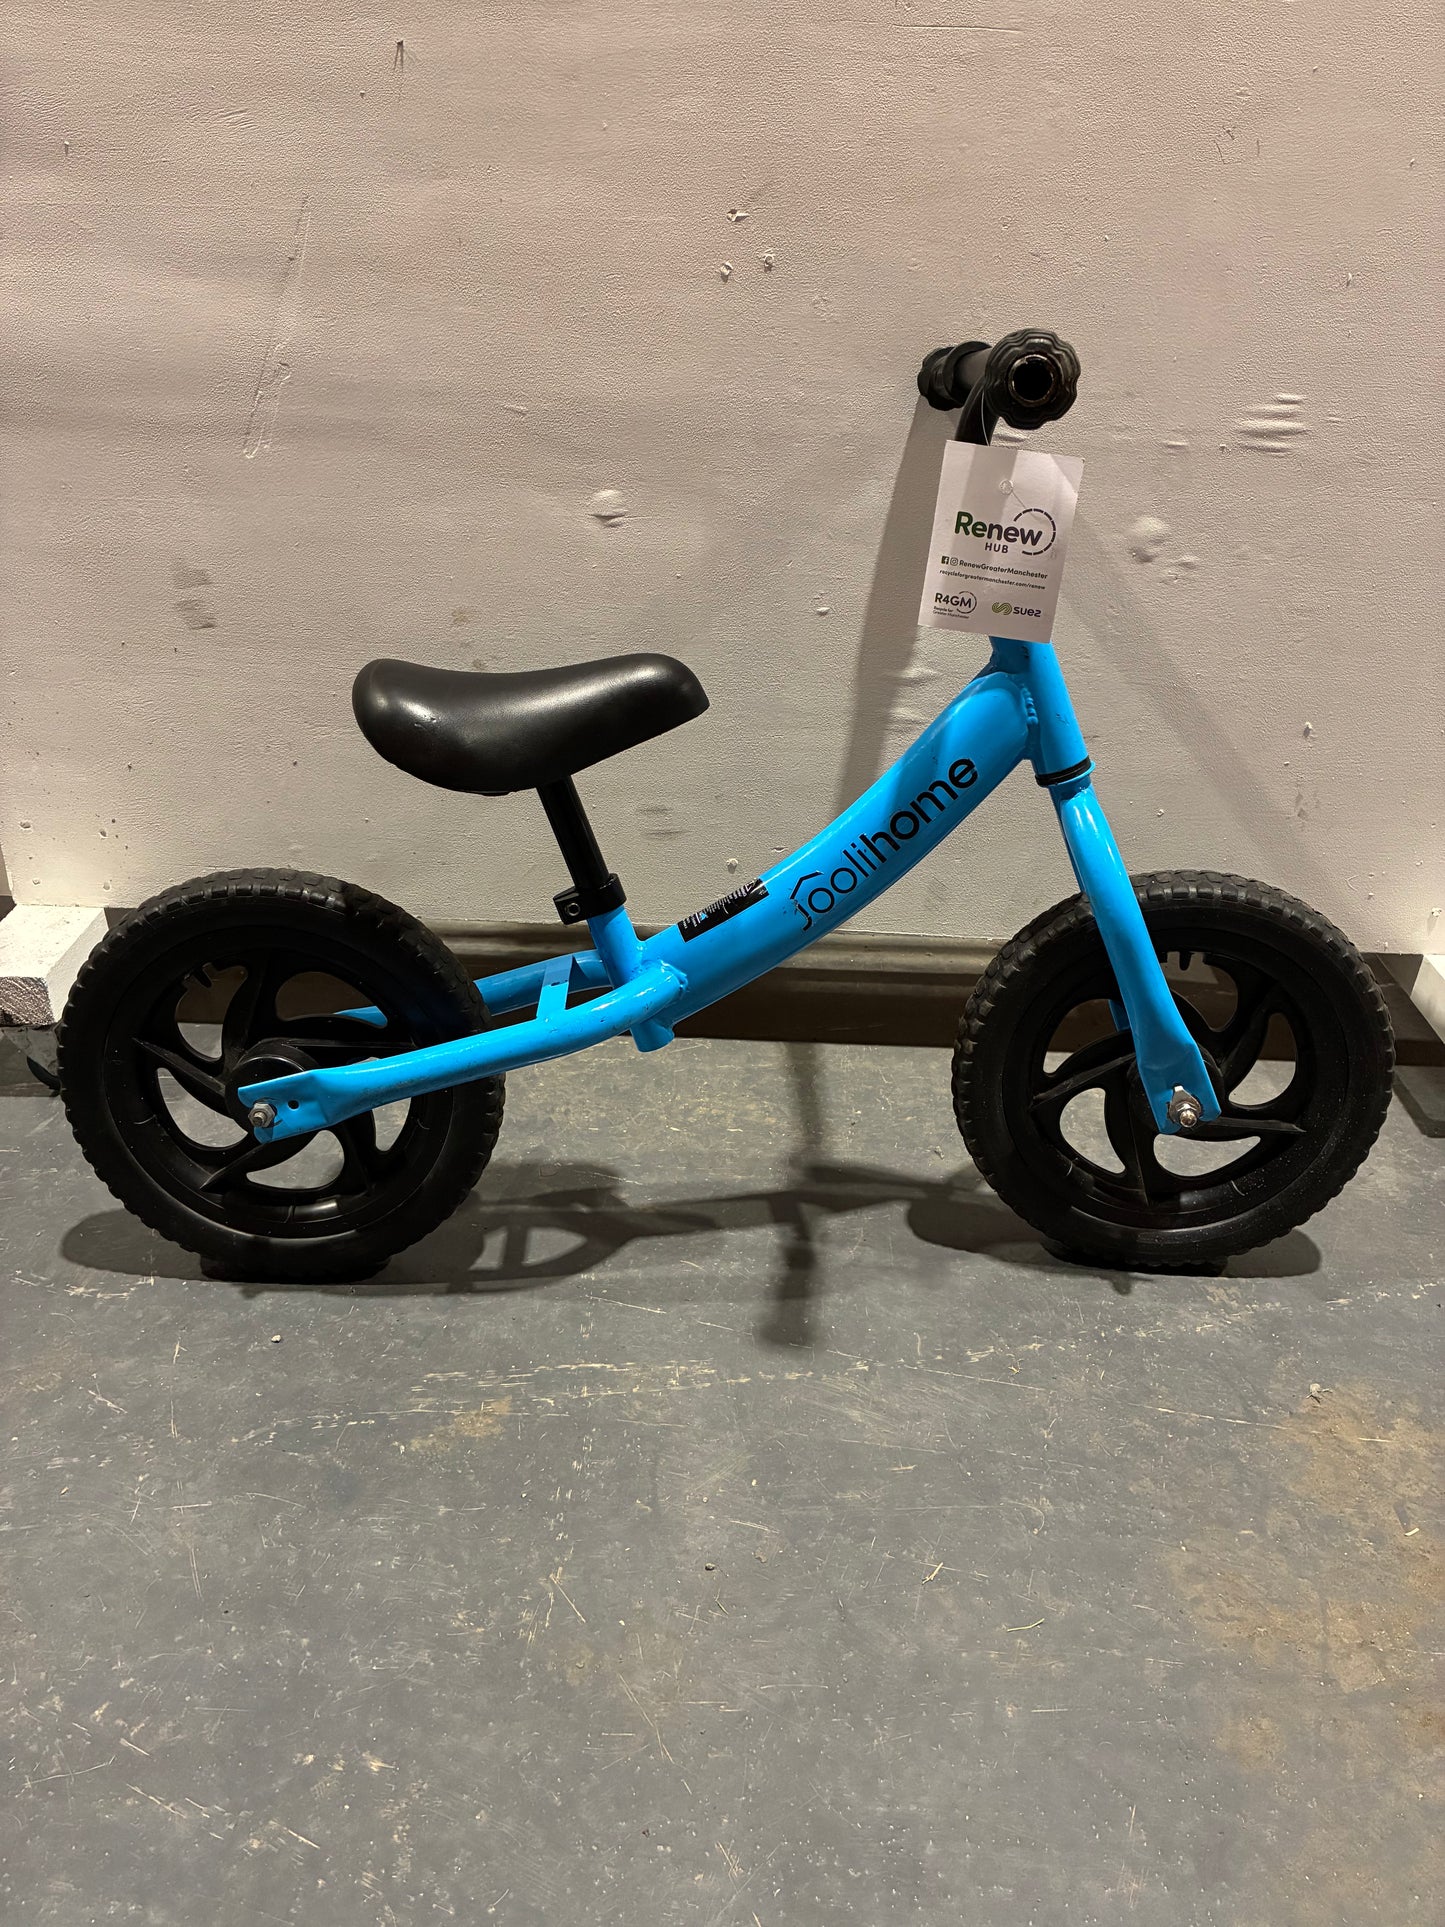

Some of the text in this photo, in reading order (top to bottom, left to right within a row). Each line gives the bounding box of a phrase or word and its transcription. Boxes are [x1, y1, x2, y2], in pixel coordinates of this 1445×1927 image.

[954, 511, 1043, 546] Renew
[984, 542, 1009, 554] HUB
[959, 560, 1048, 579] RenewGreaterManchester
[934, 592, 972, 609] R4GM
